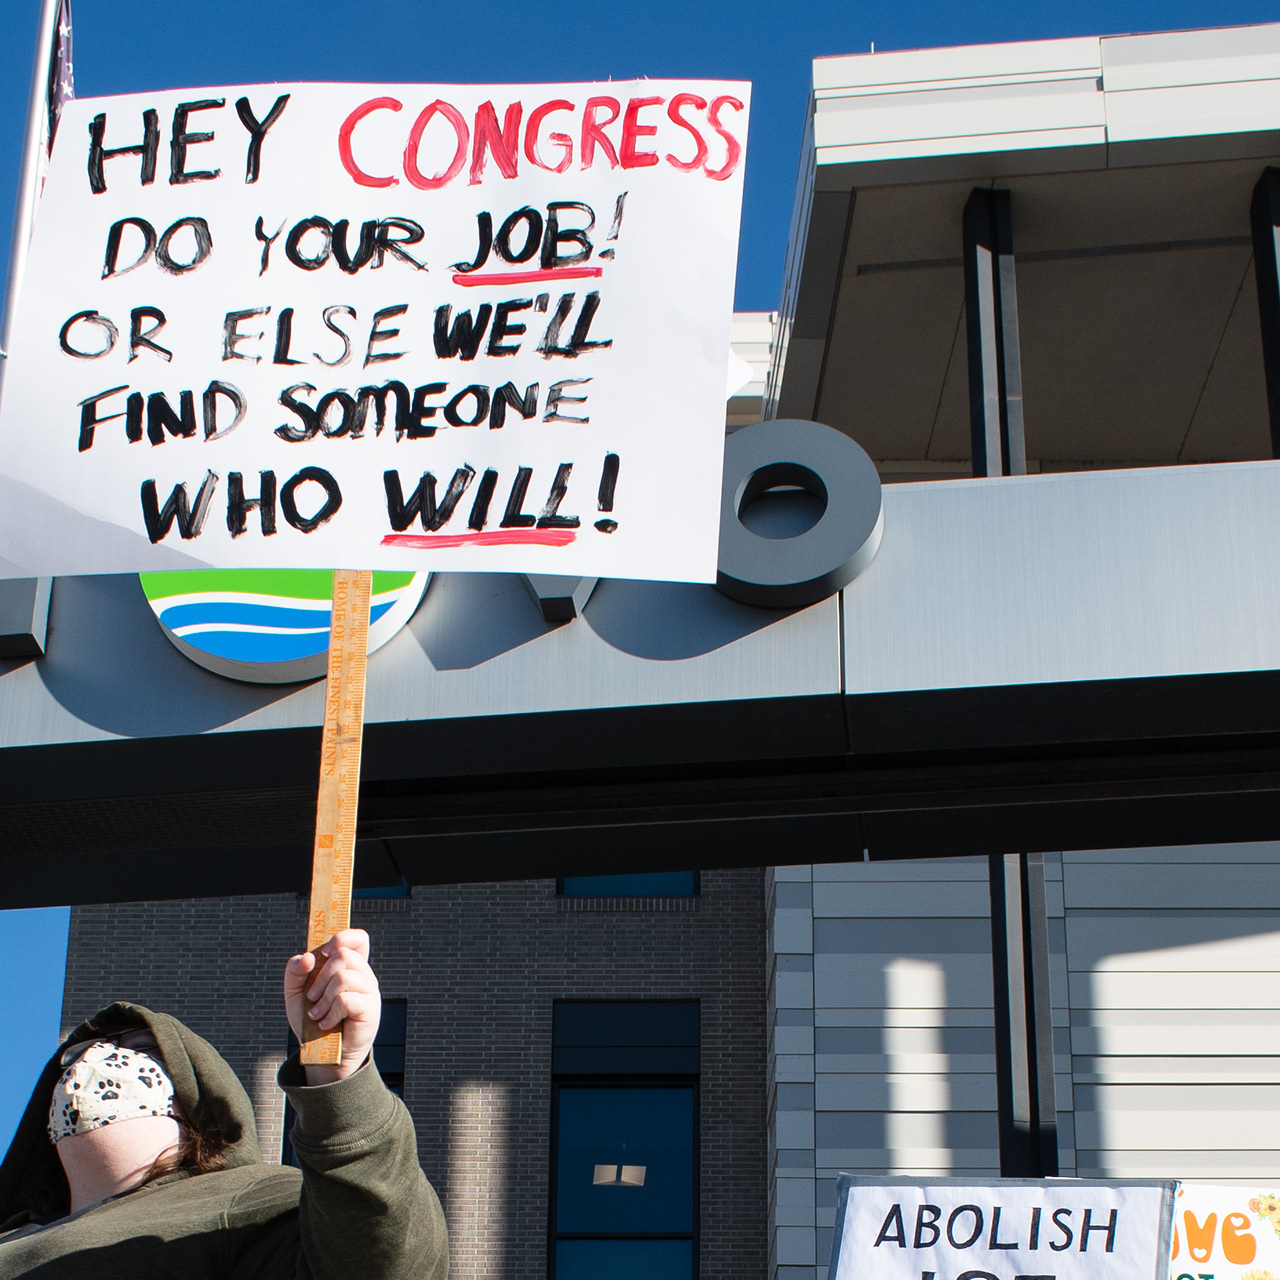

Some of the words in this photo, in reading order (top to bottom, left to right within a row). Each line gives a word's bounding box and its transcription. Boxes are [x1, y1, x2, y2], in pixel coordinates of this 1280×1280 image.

[88, 94, 290, 193] HEY
[337, 93, 744, 191] CONGRESS
[102, 218, 212, 278] DO
[256, 216, 425, 274] YOUR
[454, 192, 627, 270] JOB!
[59, 307, 172, 362] OR
[223, 305, 408, 365] ELSE
[433, 292, 612, 360] WE'LL
[79, 381, 242, 452] FIND
[275, 378, 589, 442] SOMEONE
[141, 467, 342, 544] WHO
[384, 454, 619, 533] WILL!
[335, 580, 348, 622] HOME
[333, 624, 345, 642] OF
[331, 648, 343, 674] THE
[327, 676, 341, 722] FINEST
[324, 726, 337, 777] PAINTS
[875, 1204, 1116, 1252] ABOLISH
